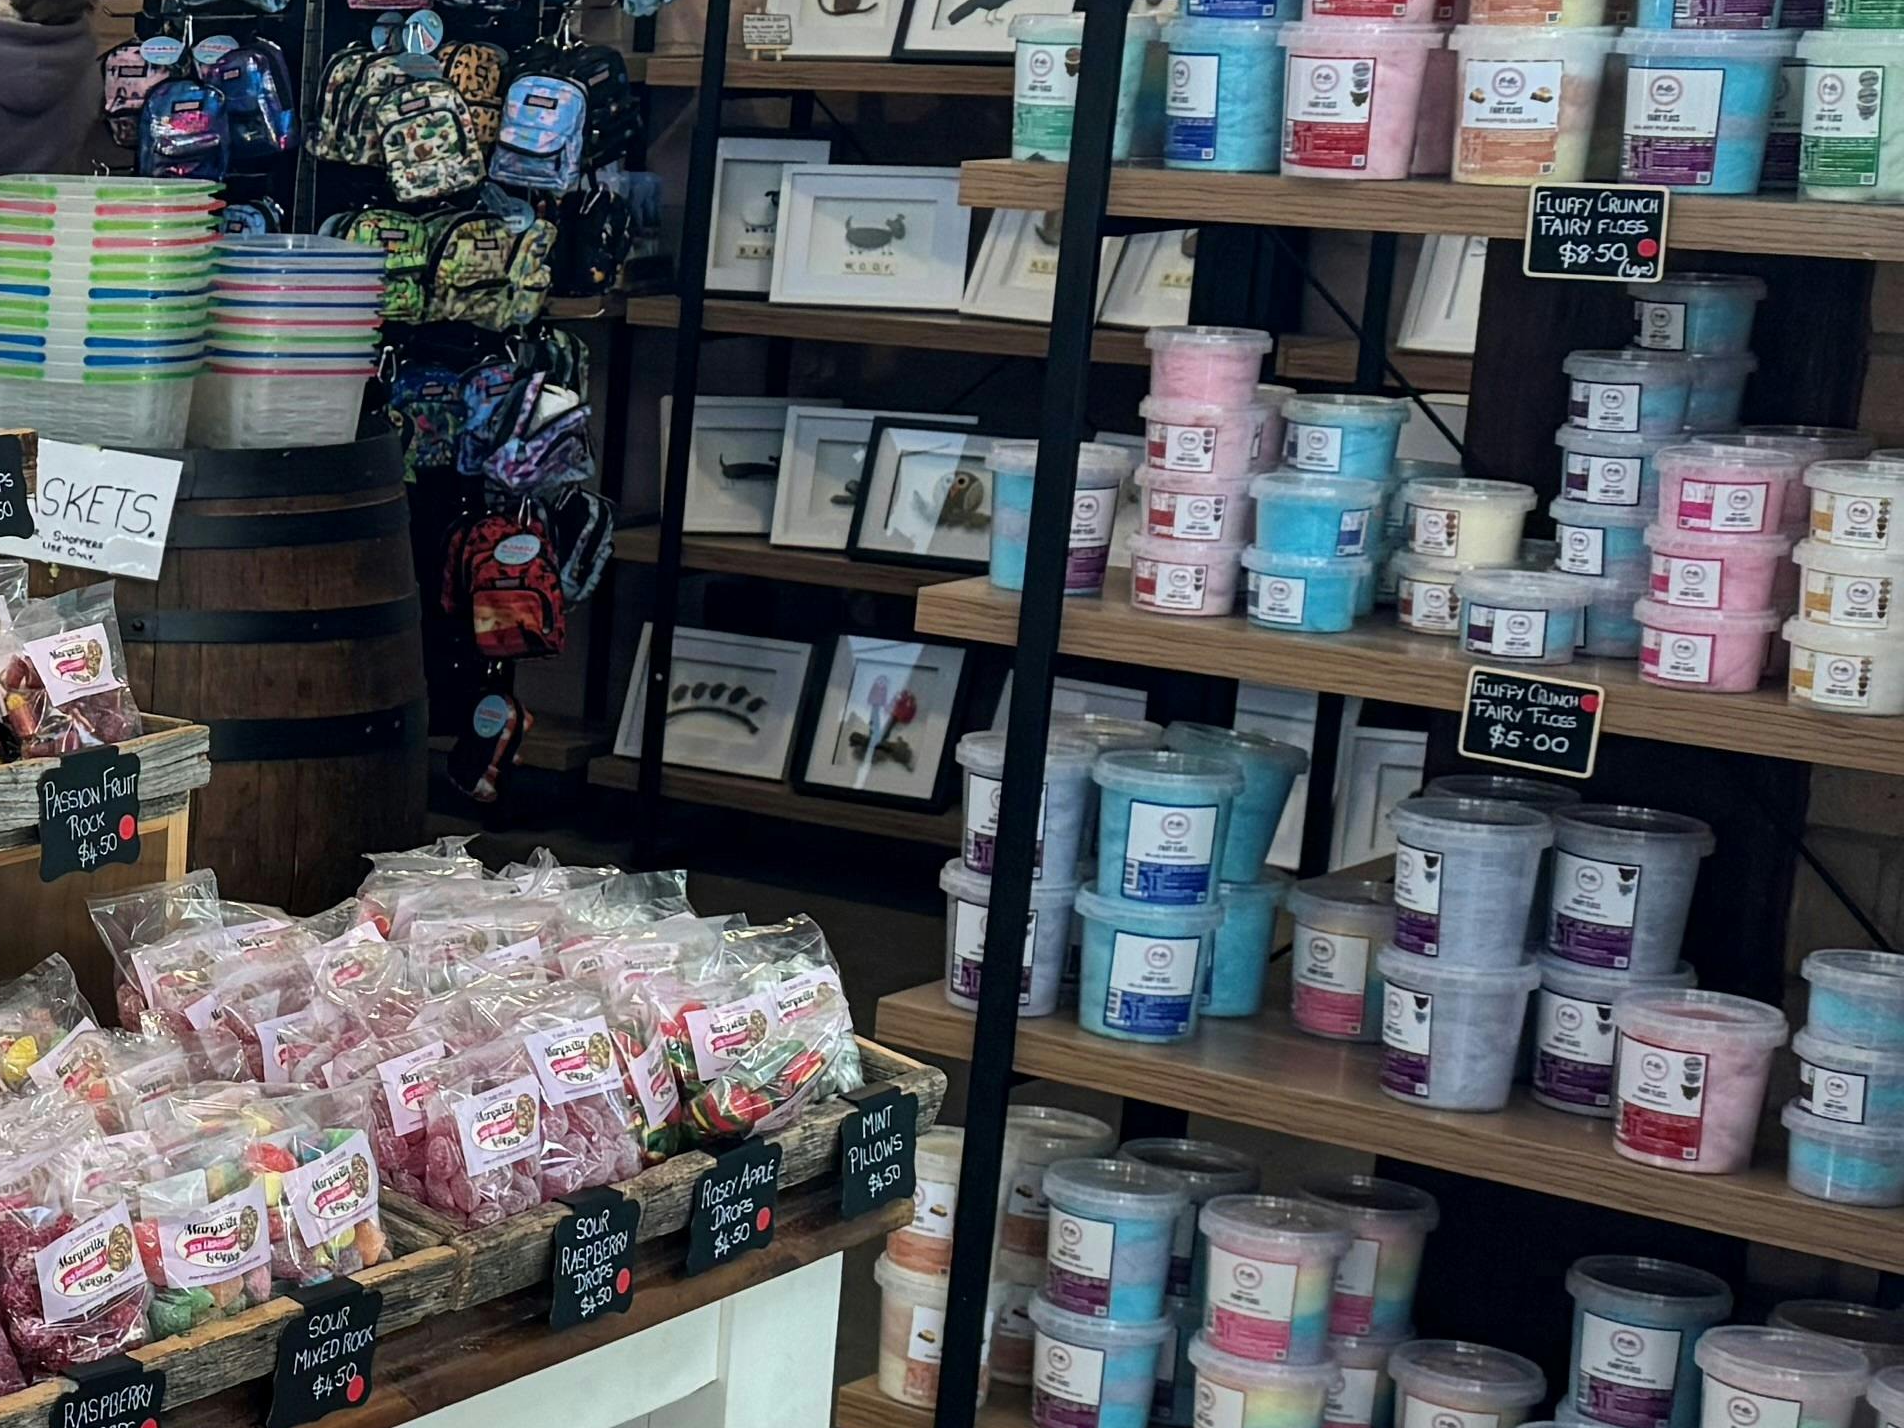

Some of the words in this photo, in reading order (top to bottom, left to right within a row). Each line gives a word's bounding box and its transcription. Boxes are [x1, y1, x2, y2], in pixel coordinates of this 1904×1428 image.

[1536, 191, 1593, 216] FLUFFY
[1598, 191, 1659, 214] CRUNCH
[1538, 216, 1592, 236] FAIRY
[1597, 219, 1649, 234] FLOSS
[53, 531, 104, 550] SHOPPERS
[1472, 675, 1525, 700] FLUFFY
[1528, 683, 1578, 708] CRUNCH
[1471, 699, 1522, 723] FAIRY
[1526, 707, 1577, 728] FLOSS
[43, 777, 102, 821] PASSION
[103, 768, 138, 800] FRUIT
[860, 1106, 895, 1140] MINT
[847, 1134, 904, 1173] PILLOWS
[739, 1157, 778, 1189] APPLE
[574, 1208, 610, 1242] SOUR
[710, 1198, 756, 1232] DROPS
[559, 1232, 631, 1274] RASPBERRY
[306, 1306, 351, 1341] SOUR
